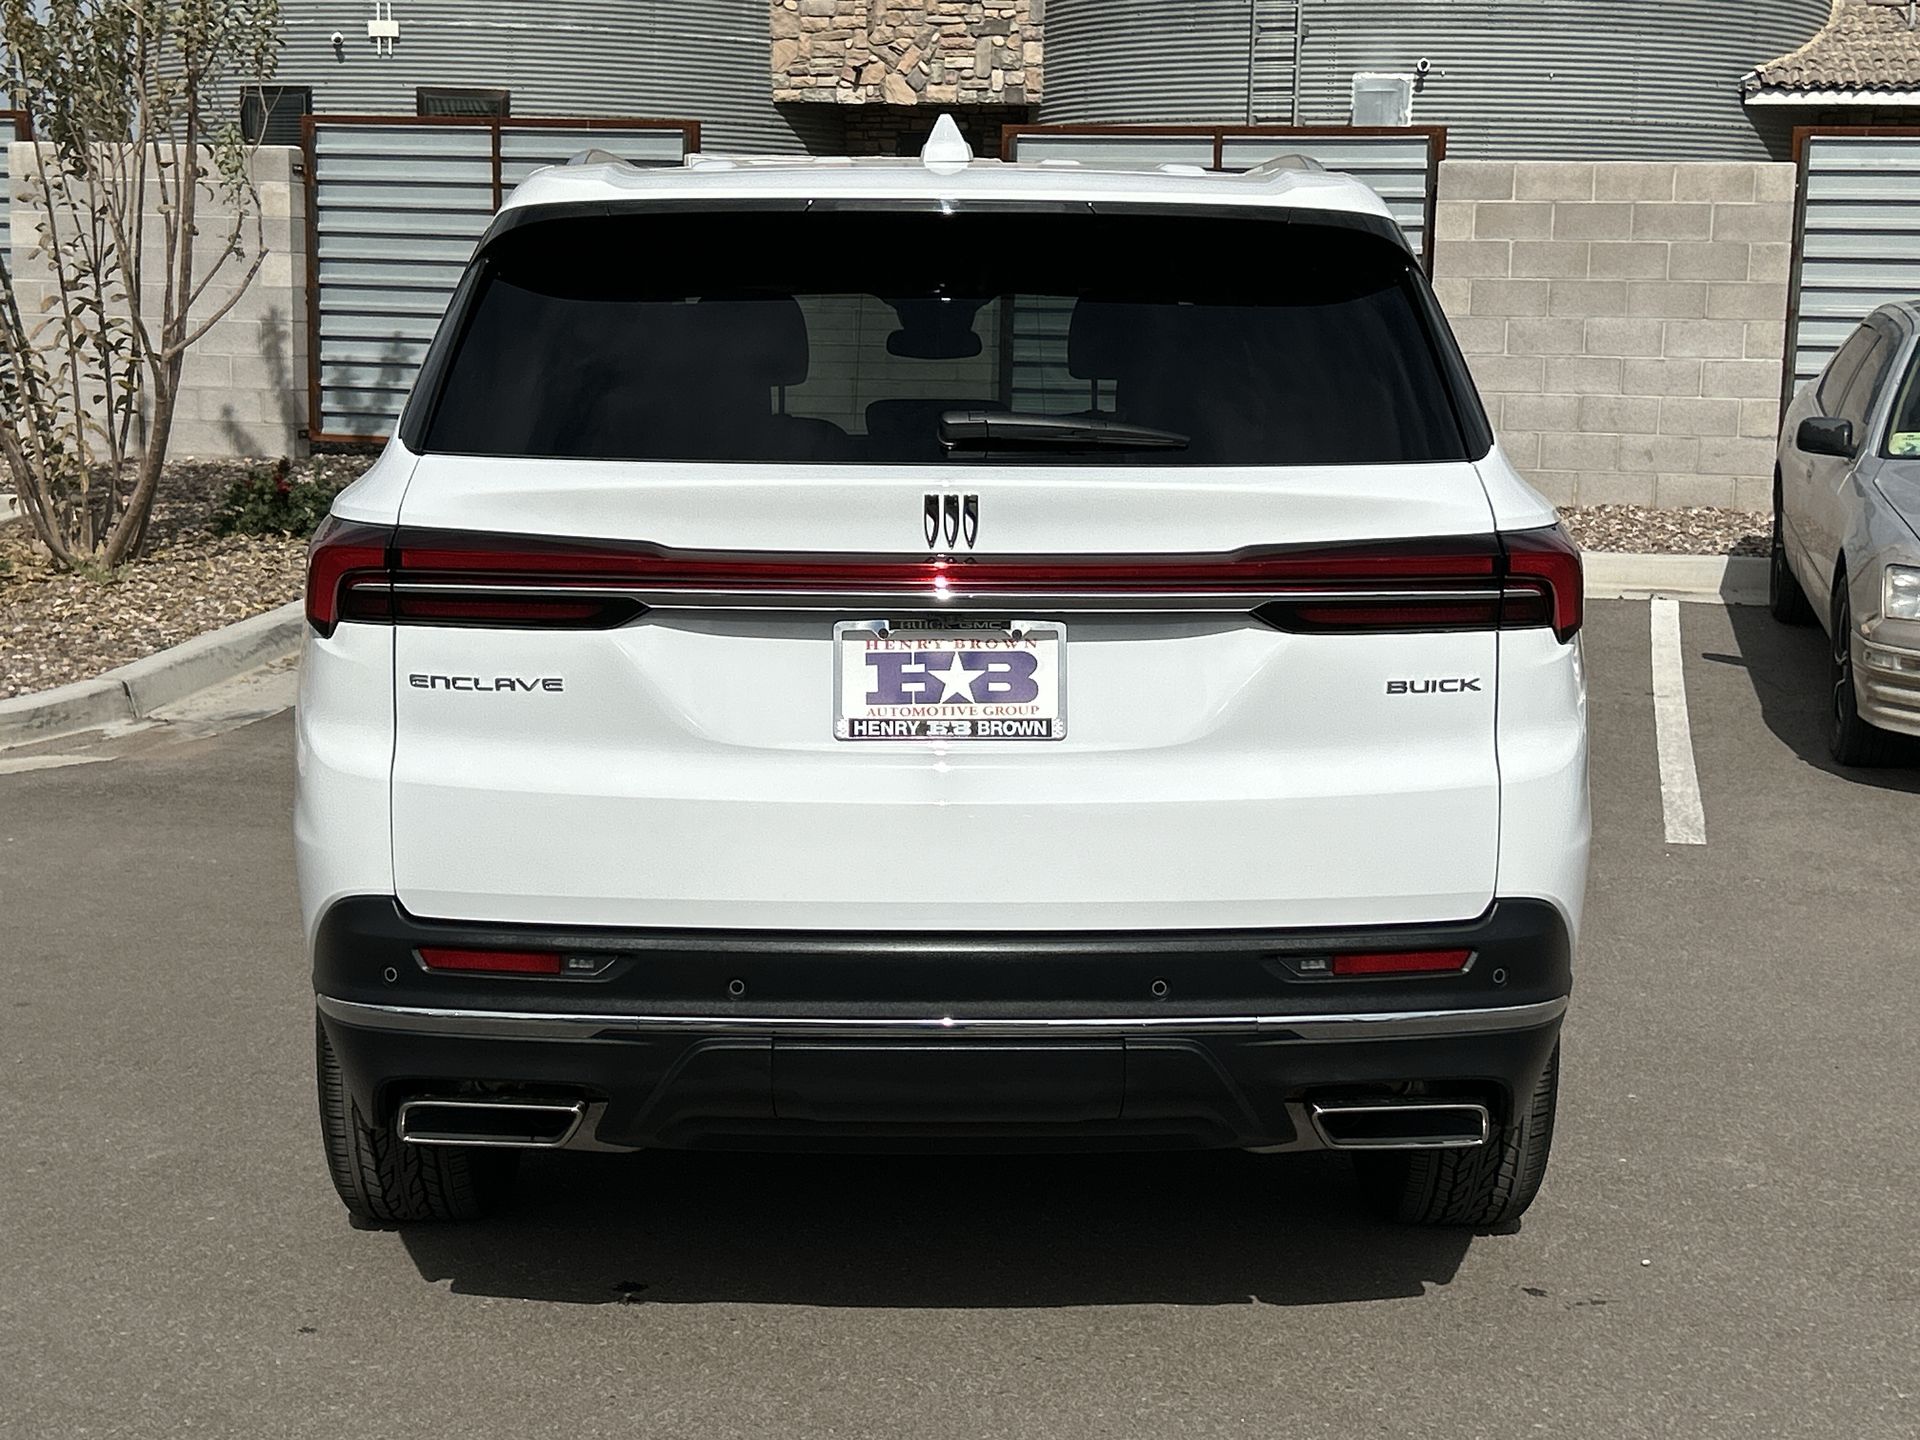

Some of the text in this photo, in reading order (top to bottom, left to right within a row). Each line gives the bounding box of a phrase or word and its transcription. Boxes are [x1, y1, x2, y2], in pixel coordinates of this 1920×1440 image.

[959, 621, 1002, 629] GMC
[866, 639, 1037, 650] HENRY BROWN
[409, 674, 564, 692] ENCLAVE
[1386, 678, 1481, 694] BUICK
[867, 706, 1040, 717] AUTOMOTIVE GROUP
[853, 721, 920, 736] HENRY
[977, 721, 1047, 736] BROWN
